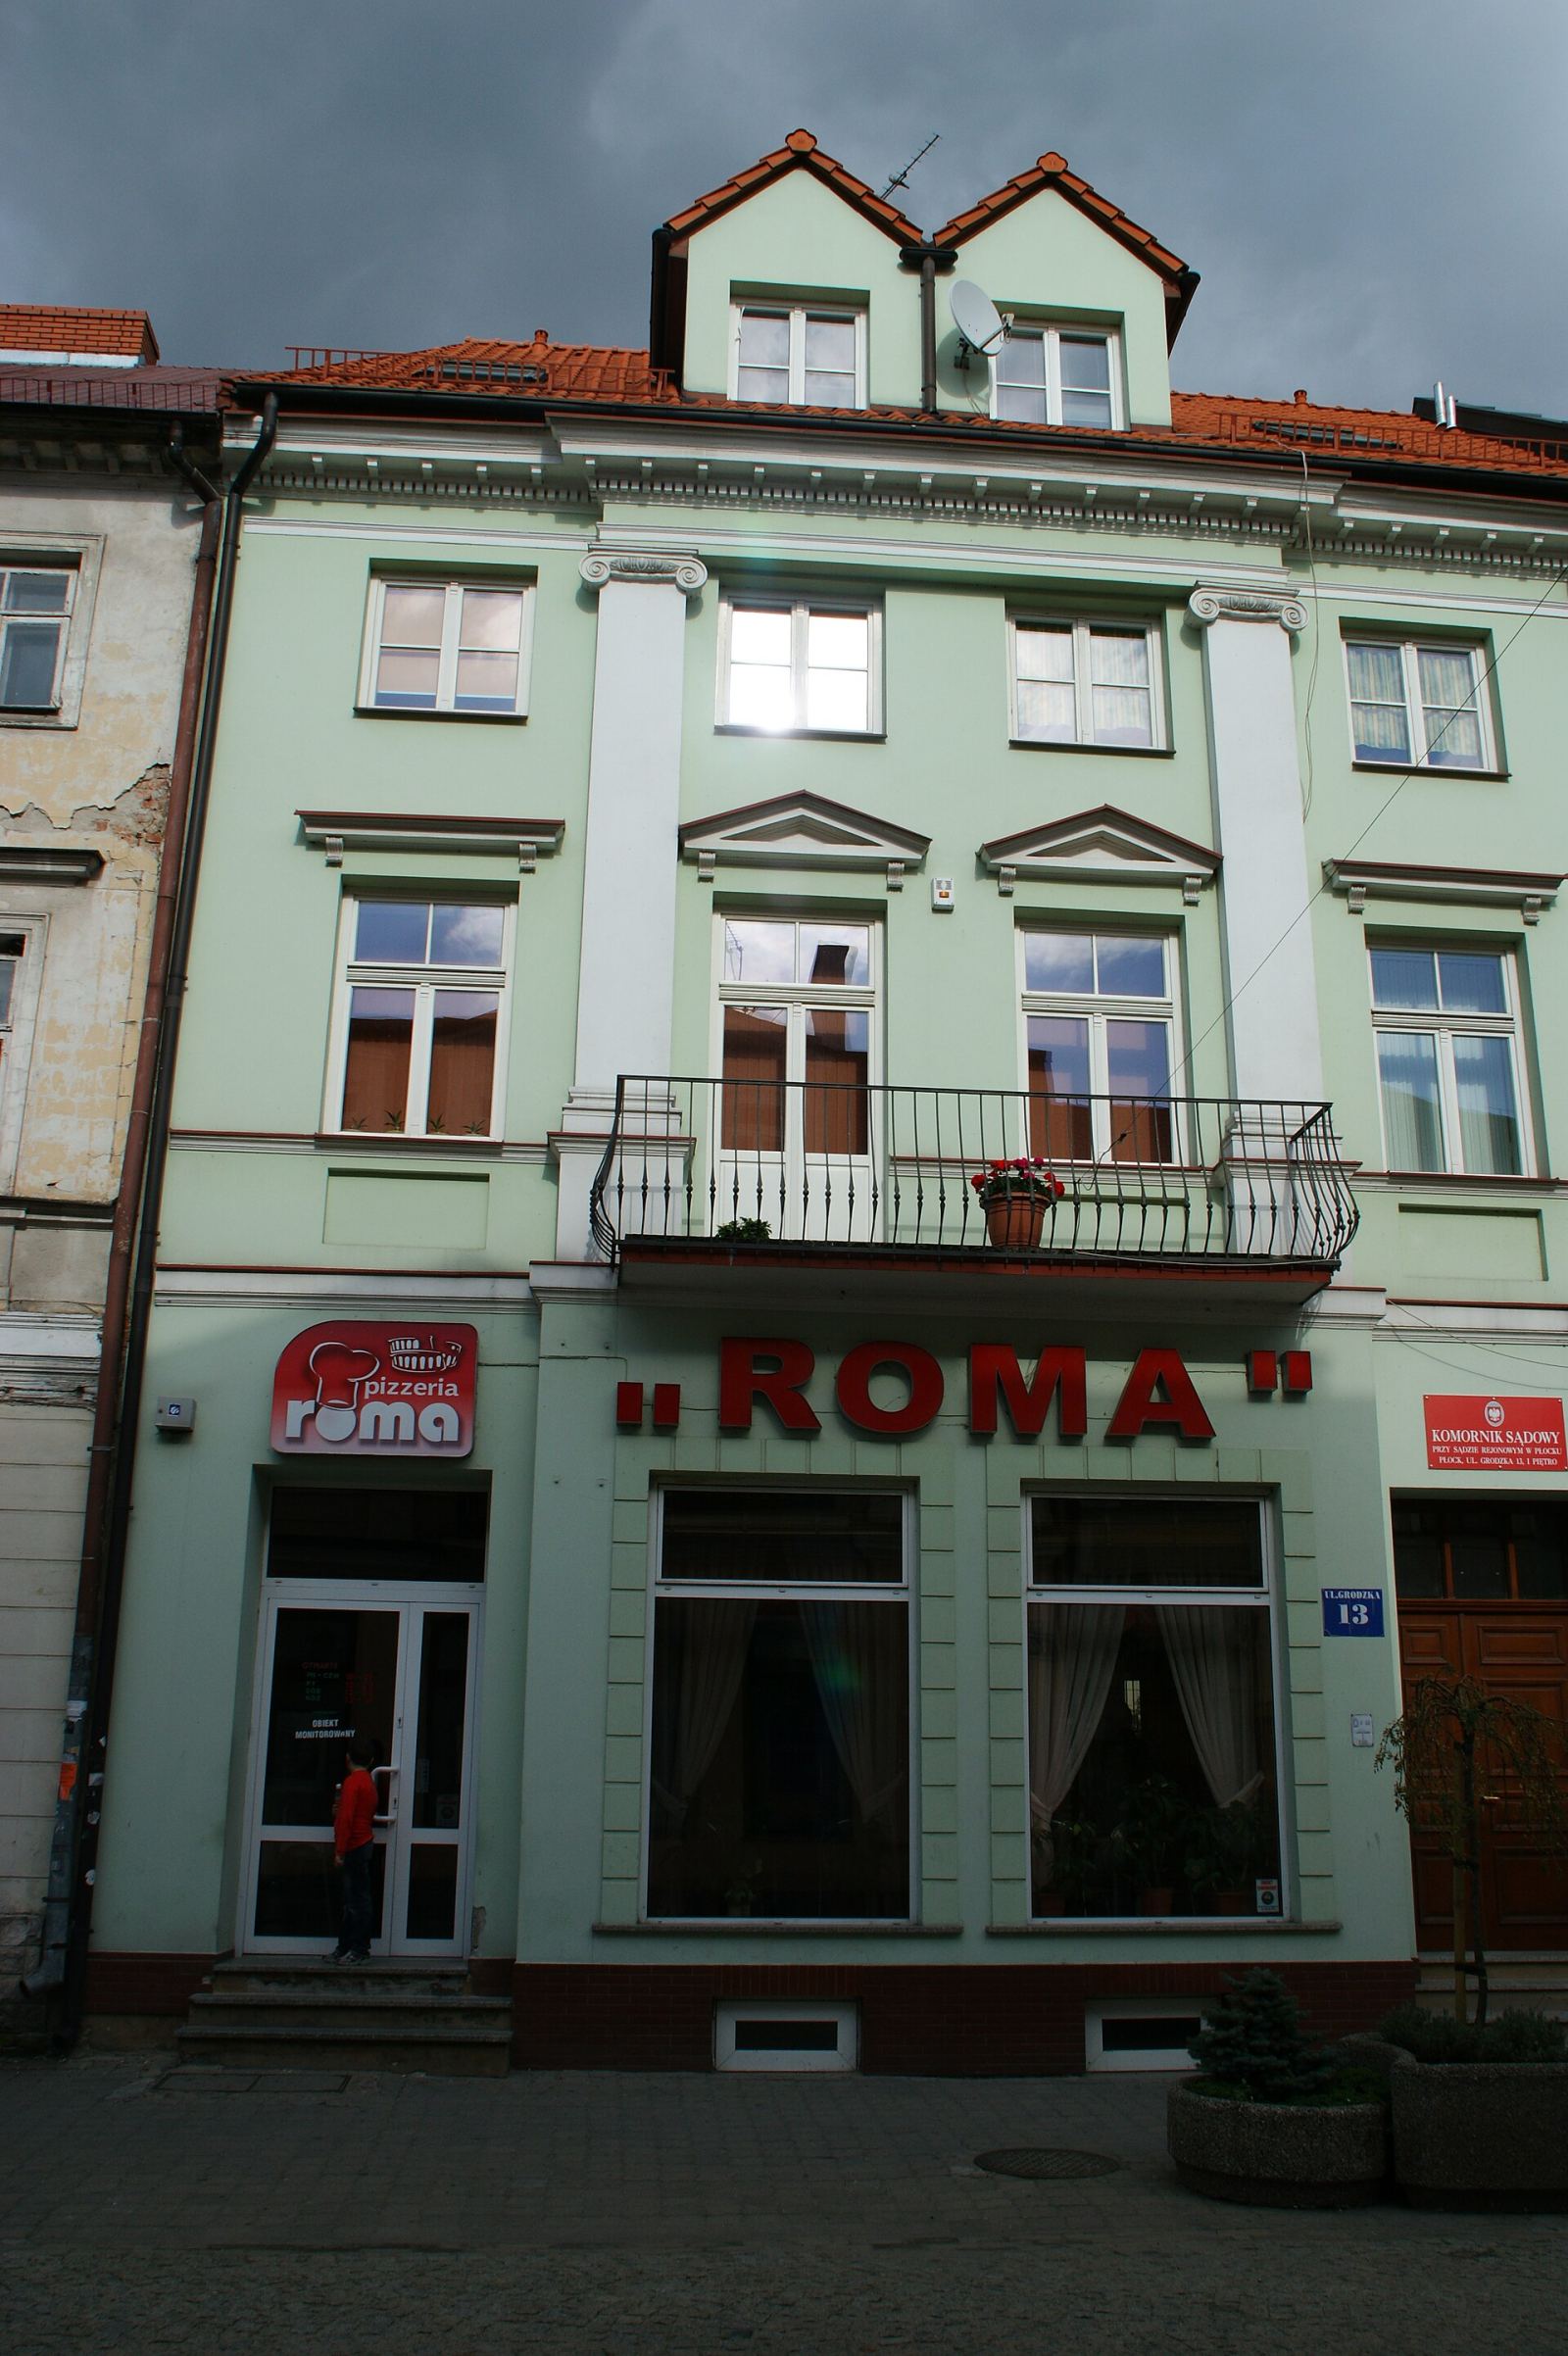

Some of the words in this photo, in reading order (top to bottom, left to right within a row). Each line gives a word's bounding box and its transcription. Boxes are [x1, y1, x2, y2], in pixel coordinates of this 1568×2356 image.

[364, 1376, 459, 1399] pizzeria
[285, 1399, 460, 1443] roma
[1432, 1429, 1504, 1444] KOMORNIK
[1506, 1431, 1560, 1447] SĄDOWY
[1453, 1446, 1478, 1455] SĄDZIE
[1338, 1604, 1369, 1625] 13
[312, 1719, 339, 1728] OBIEKT
